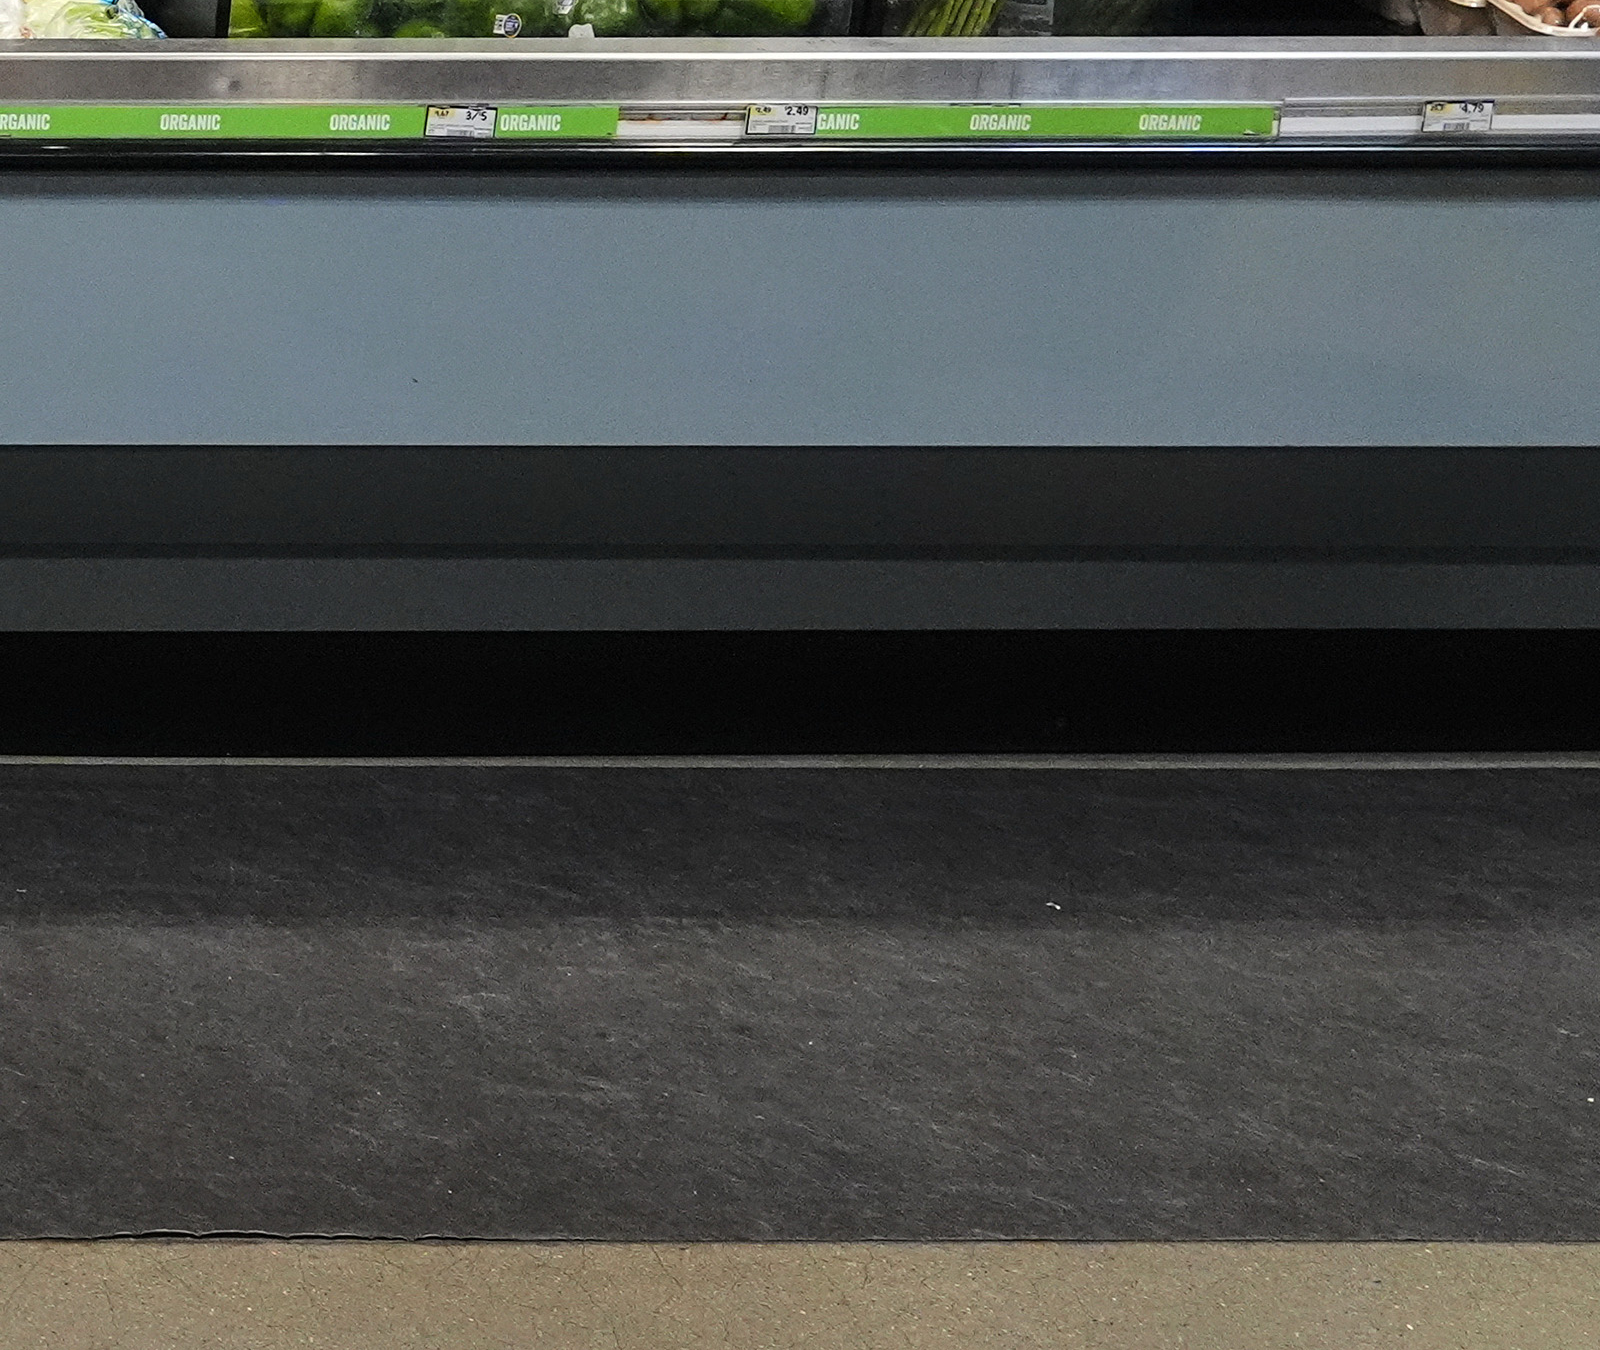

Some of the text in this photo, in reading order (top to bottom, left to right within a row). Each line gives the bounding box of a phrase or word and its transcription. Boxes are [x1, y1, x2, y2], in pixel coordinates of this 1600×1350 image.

[160, 114, 221, 131] ORGANIC
[329, 114, 390, 131] ORGANIC
[500, 114, 561, 131] ORGANIC
[817, 113, 860, 130] GANIC
[969, 114, 1031, 131] ORGANIC
[1139, 114, 1202, 131] ORGANIC
